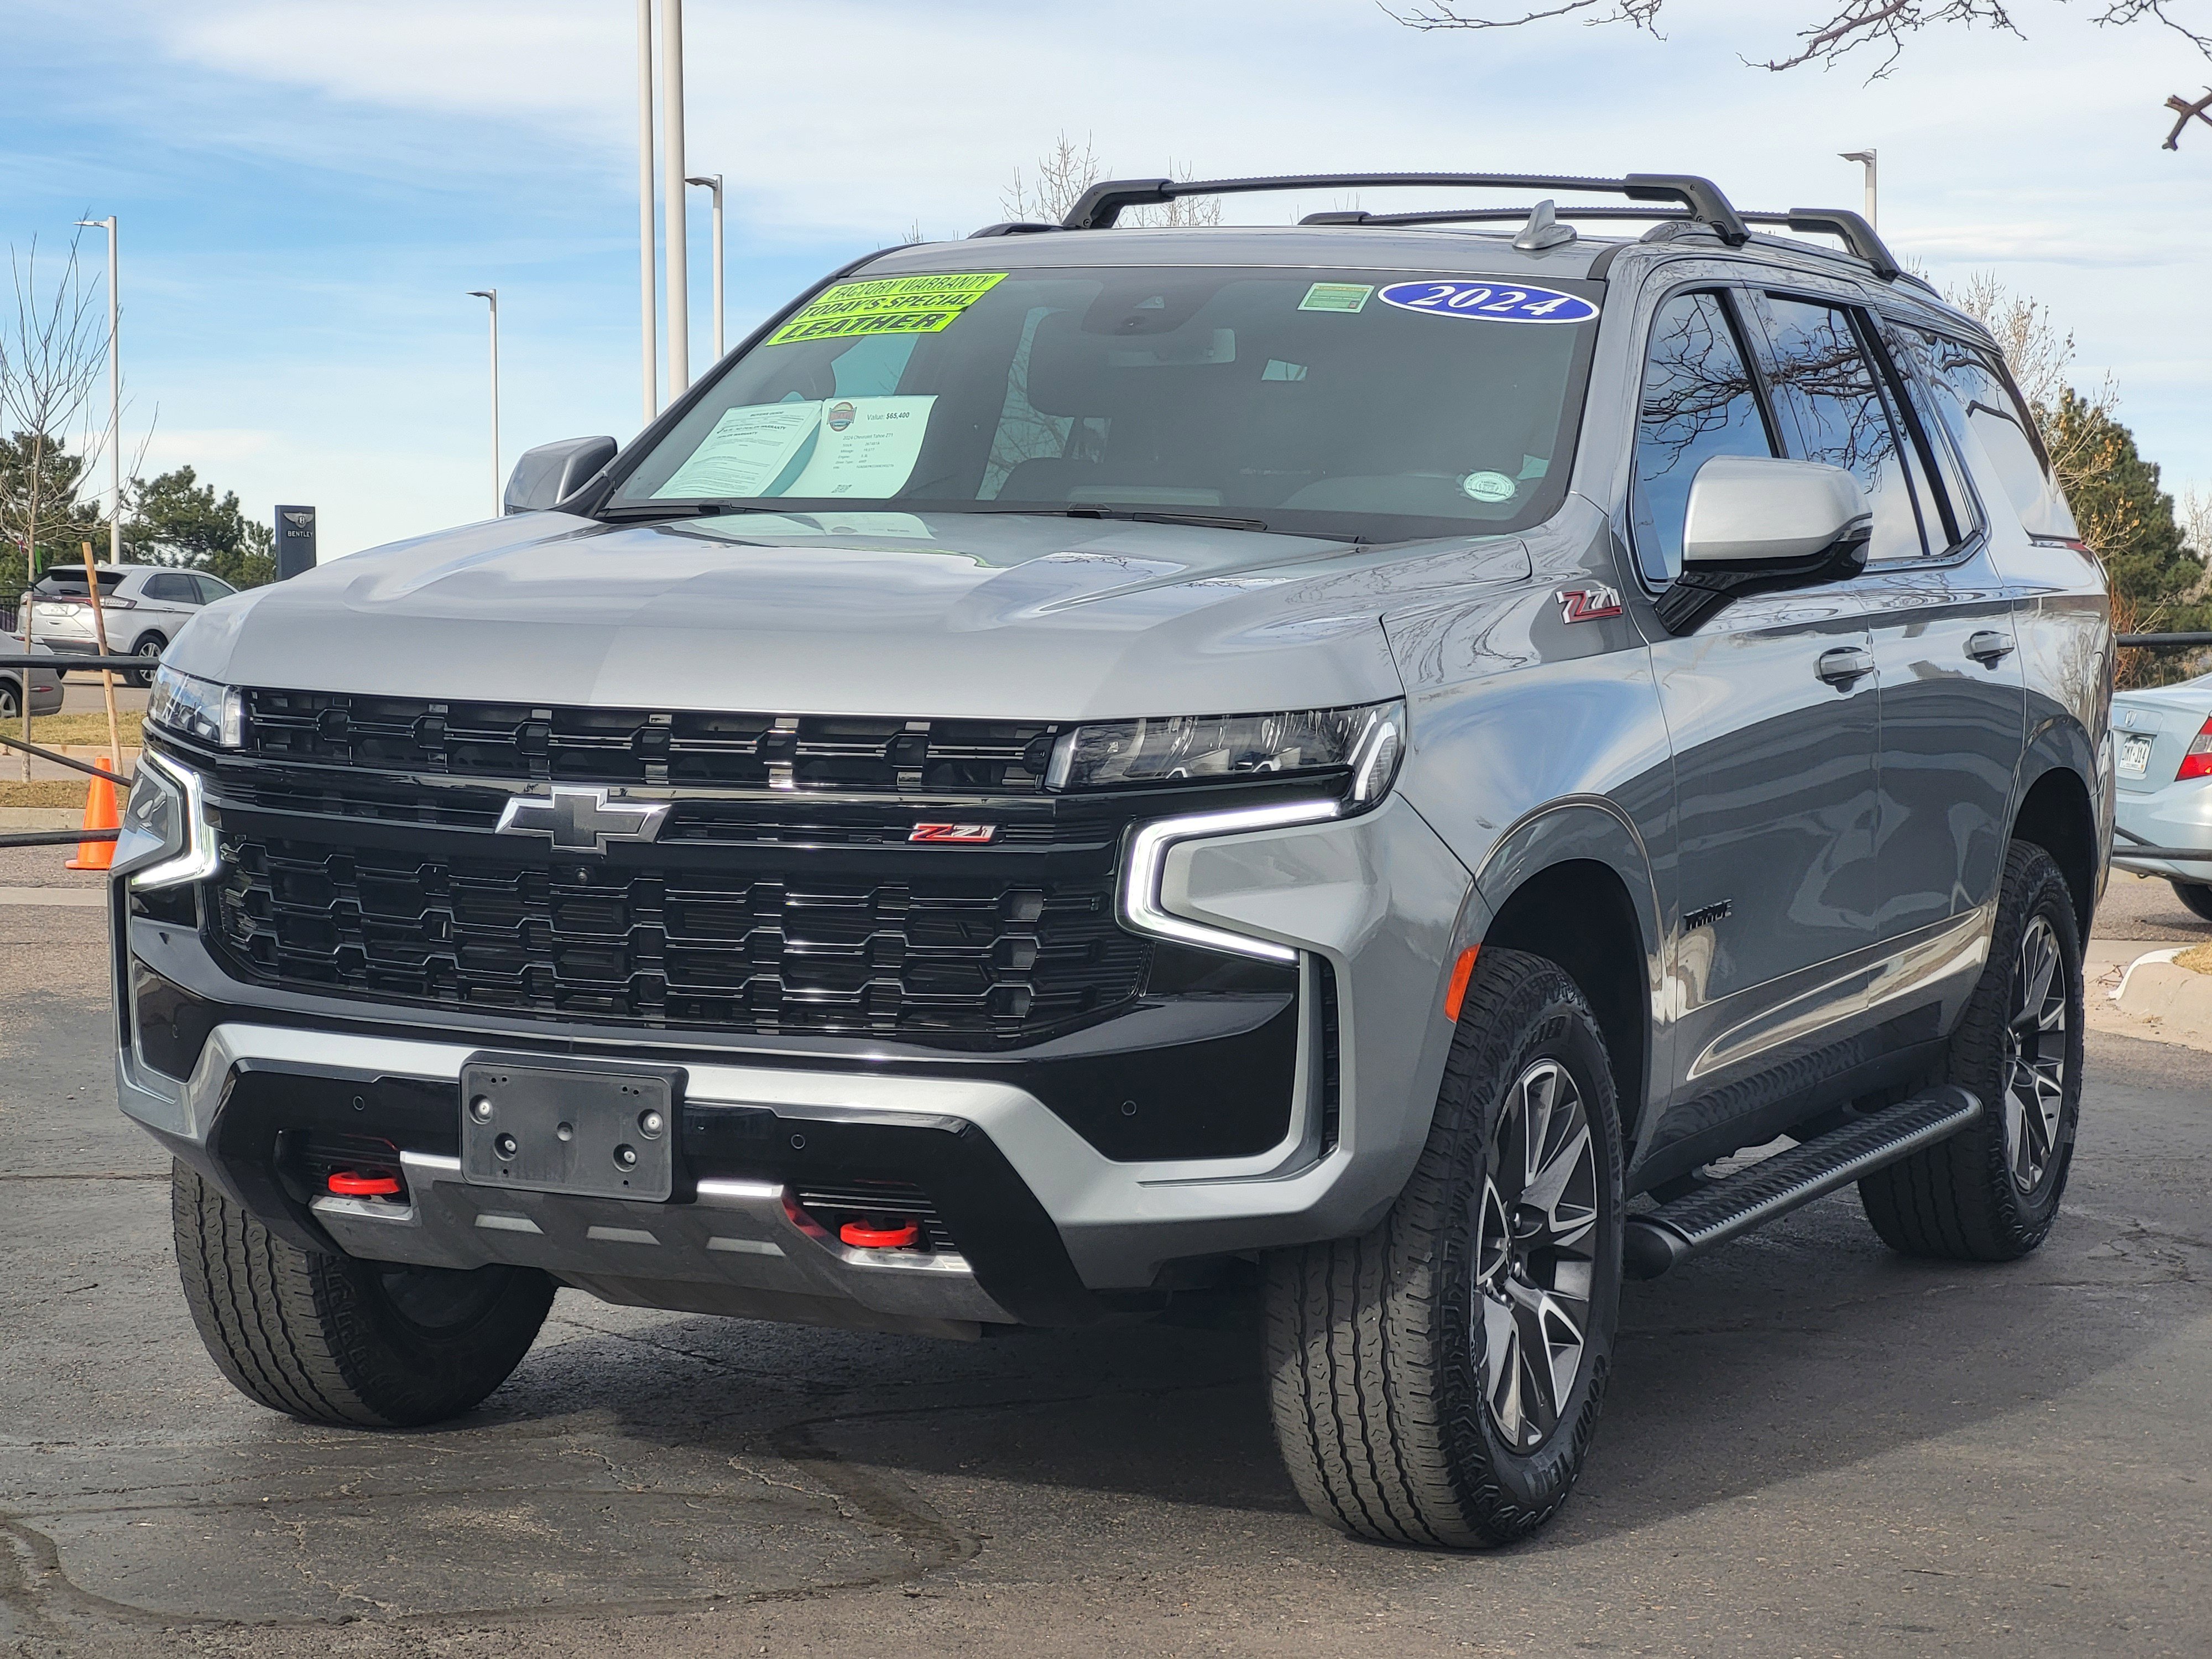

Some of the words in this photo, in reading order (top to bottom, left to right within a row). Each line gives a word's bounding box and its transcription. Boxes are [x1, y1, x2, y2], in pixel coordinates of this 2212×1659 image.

[827, 280, 905, 301] FACTORY
[899, 276, 997, 292] WARRANTY
[1407, 285, 1571, 316] 2024
[798, 298, 887, 320] TODAY'S
[883, 294, 977, 310] SPECIAL
[777, 314, 949, 342] LEATHER
[886, 411, 910, 420] $65,400
[1555, 587, 1623, 624] Z71
[907, 822, 997, 843] Z71
